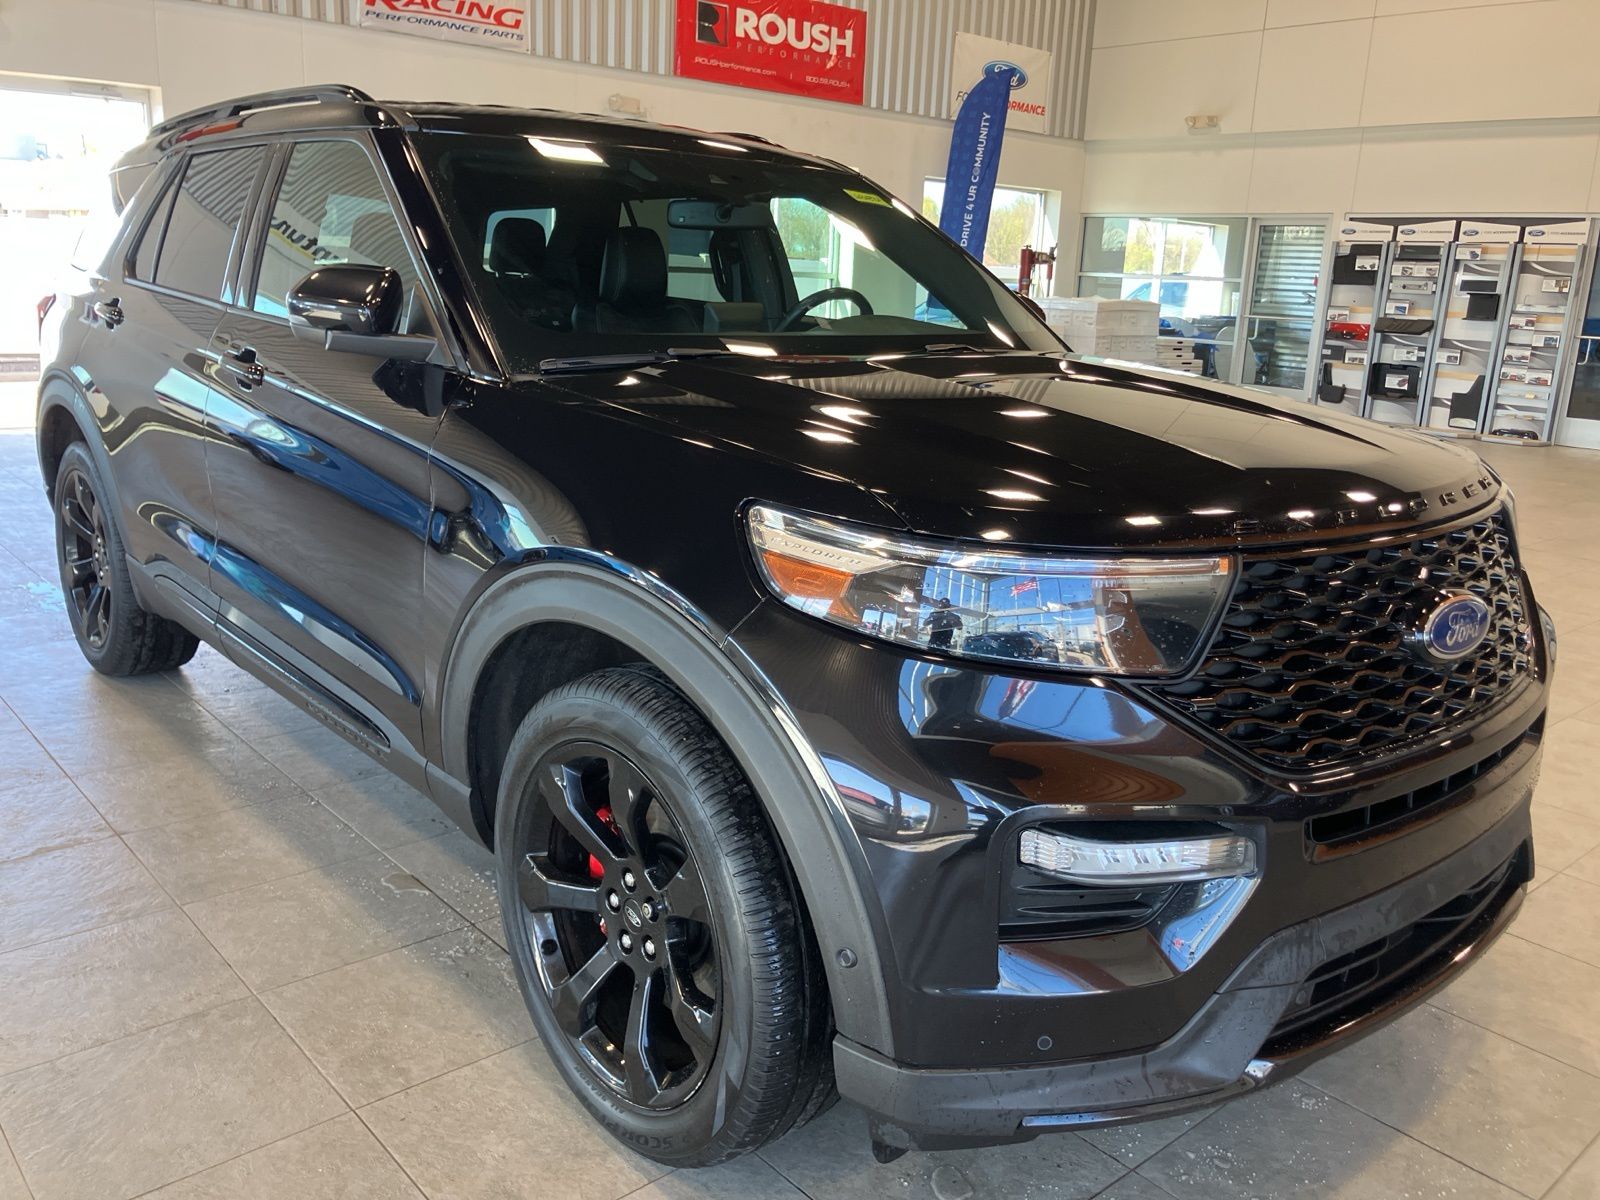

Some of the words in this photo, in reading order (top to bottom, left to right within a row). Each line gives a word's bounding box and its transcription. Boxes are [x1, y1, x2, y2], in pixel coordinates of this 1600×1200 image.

[365, 0, 524, 29] ACING
[365, 9, 479, 34] PERFORMANCE
[482, 28, 524, 41] PARTS
[735, 7, 854, 57] ROUSH
[1007, 100, 1046, 116] ORMANCE
[971, 112, 991, 183] COMMUNITY
[965, 203, 975, 211] 4
[967, 185, 978, 202] UR
[960, 213, 973, 247] DRIVE
[1446, 608, 1479, 646] Ford
